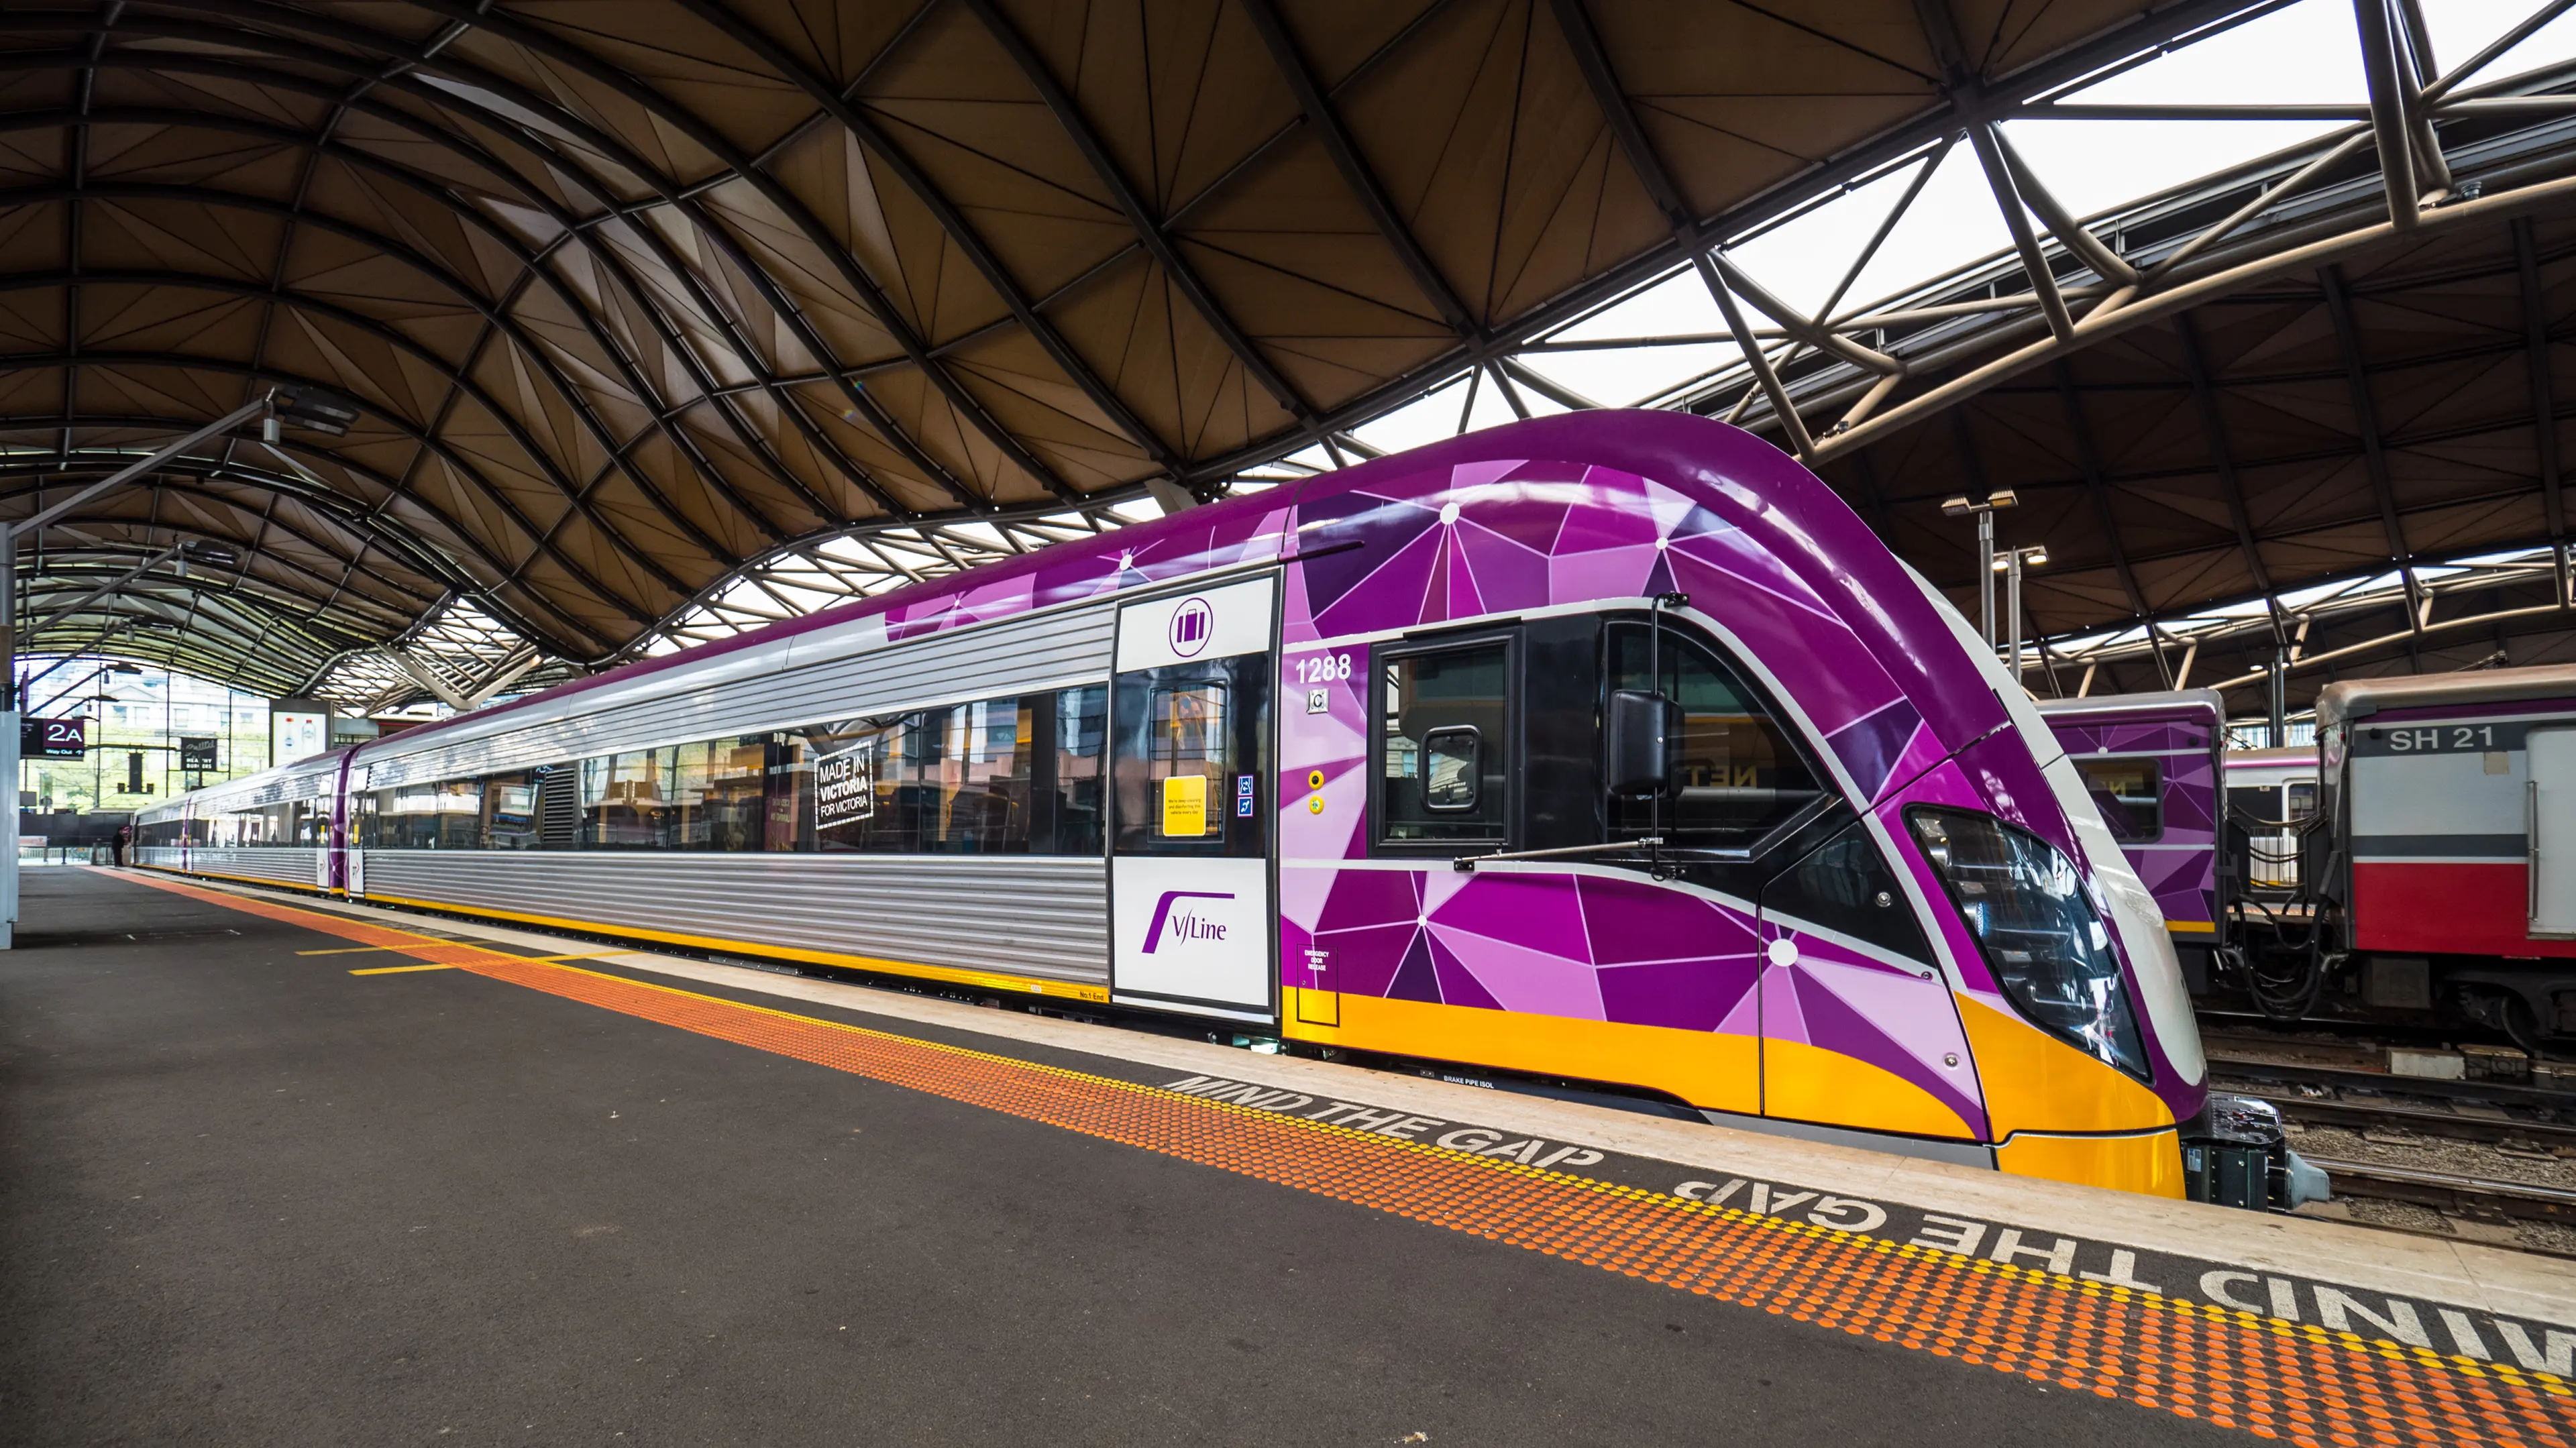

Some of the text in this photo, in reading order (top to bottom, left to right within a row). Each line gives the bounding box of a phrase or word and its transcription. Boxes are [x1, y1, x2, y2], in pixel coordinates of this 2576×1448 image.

[1296, 653, 1351, 684] 1288
[1313, 694, 1323, 708] C
[48, 724, 83, 742] 2A
[2390, 726, 2492, 751] SH 21
[820, 754, 865, 783] MADE IN
[820, 775, 868, 802] VICTORIA
[820, 795, 867, 818] FOR VICTORIA
[1093, 993, 1104, 1001] End
[1444, 1075, 1494, 1089] BRAKE PIPE ISOL
[1159, 1076, 1605, 1169] MIND THE GAP
[1674, 1178, 2576, 1377] MIND THE GAP
